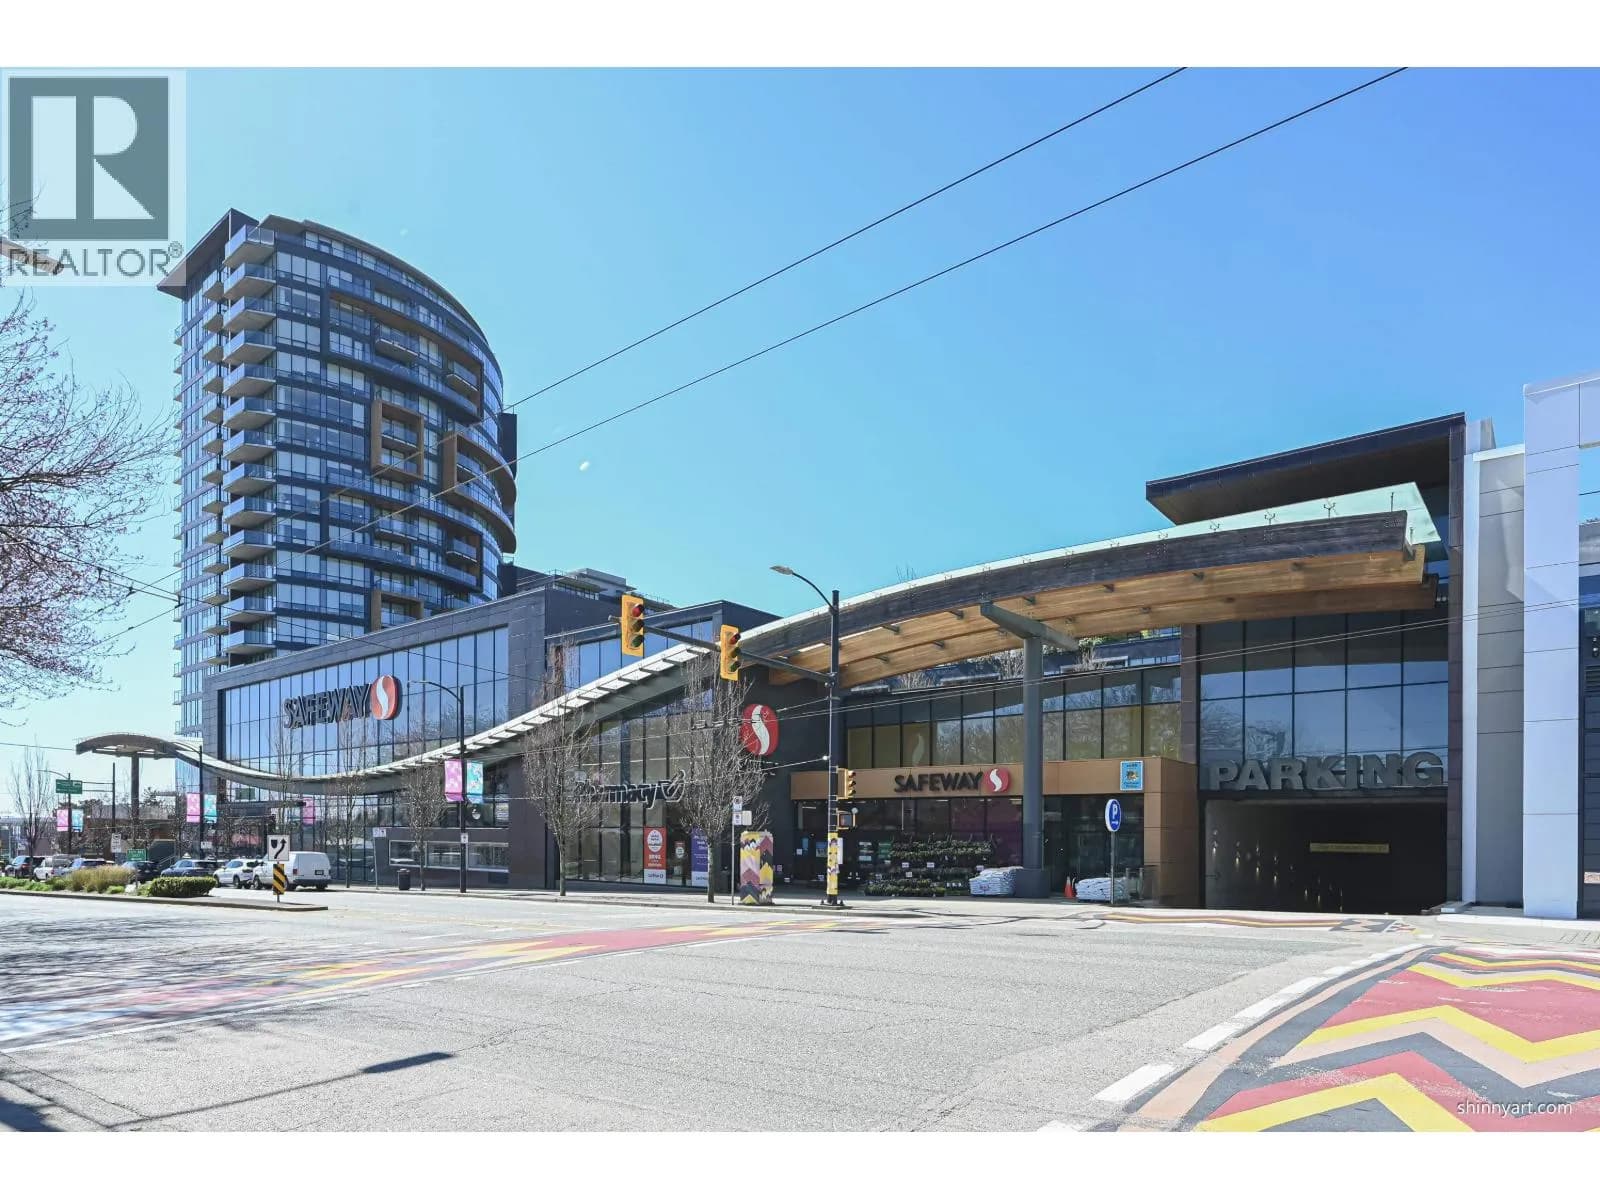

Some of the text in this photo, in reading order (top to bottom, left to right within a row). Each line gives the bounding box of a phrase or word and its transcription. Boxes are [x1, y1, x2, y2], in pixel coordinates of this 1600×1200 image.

[284, 682, 371, 729] SAFEWAY
[894, 771, 984, 793] SAFEWAY
[1209, 751, 1444, 790] PARKING
[1112, 803, 1119, 820] P
